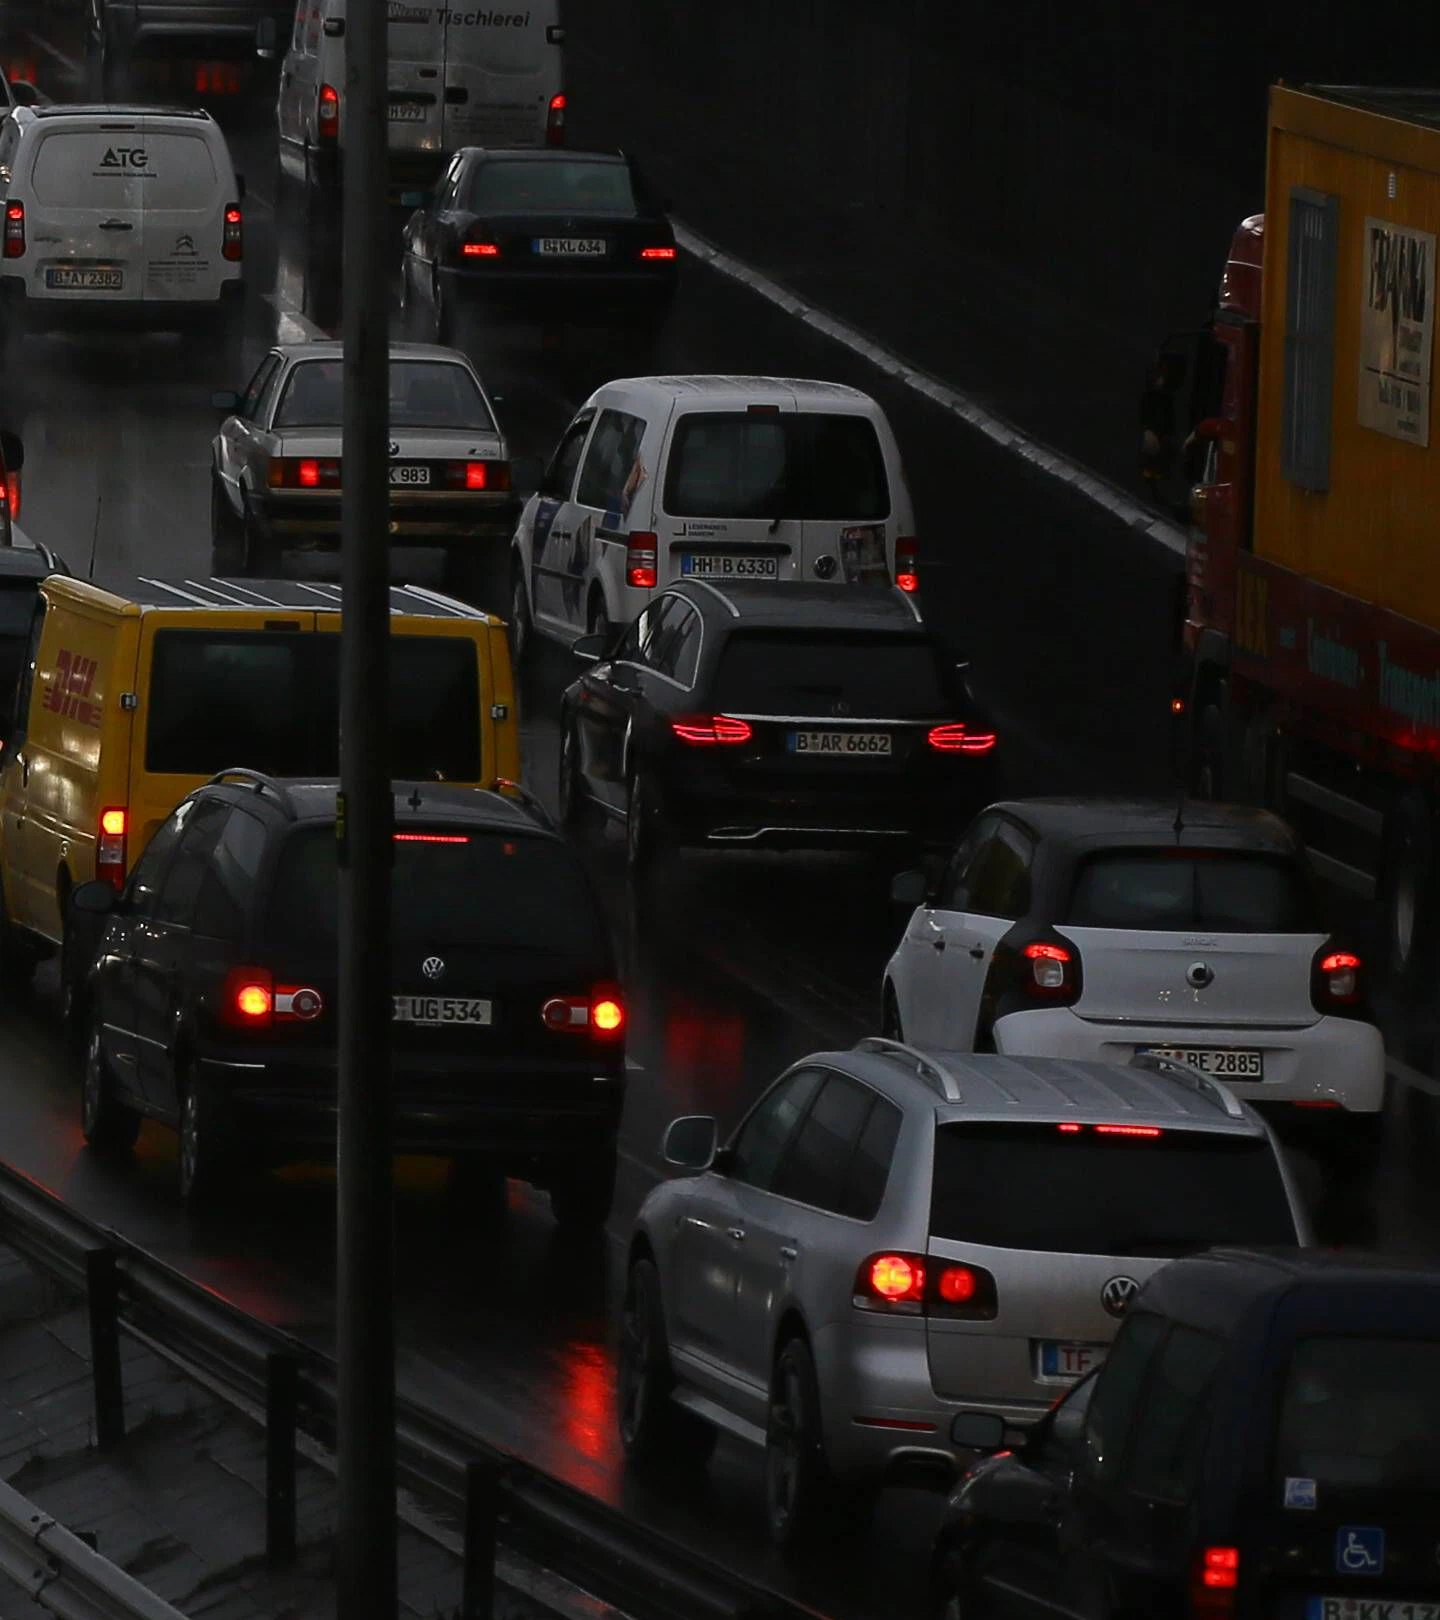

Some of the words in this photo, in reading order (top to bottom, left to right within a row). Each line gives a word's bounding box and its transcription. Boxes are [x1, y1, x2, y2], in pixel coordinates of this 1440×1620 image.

[436, 7, 530, 28] Tischlerei
[100, 147, 149, 168] ATG
[543, 239, 552, 252] B
[559, 239, 576, 253] KL
[578, 240, 601, 253] 634
[55, 272, 64, 285] B
[71, 272, 88, 285] AT
[91, 272, 120, 285] 2382
[401, 468, 427, 482] 983
[692, 557, 712, 573] HH
[722, 558, 733, 573] B
[737, 559, 775, 574] 6330
[797, 735, 808, 749] B
[820, 736, 842, 751] AR
[847, 736, 890, 753] 6662
[411, 999, 439, 1021] UG
[443, 1000, 481, 1022] 534
[1215, 1051, 1260, 1074] 2885
[1061, 1347, 1091, 1371] TF
[1324, 1596, 1340, 1620] B
[1359, 1598, 1390, 1620] KK
